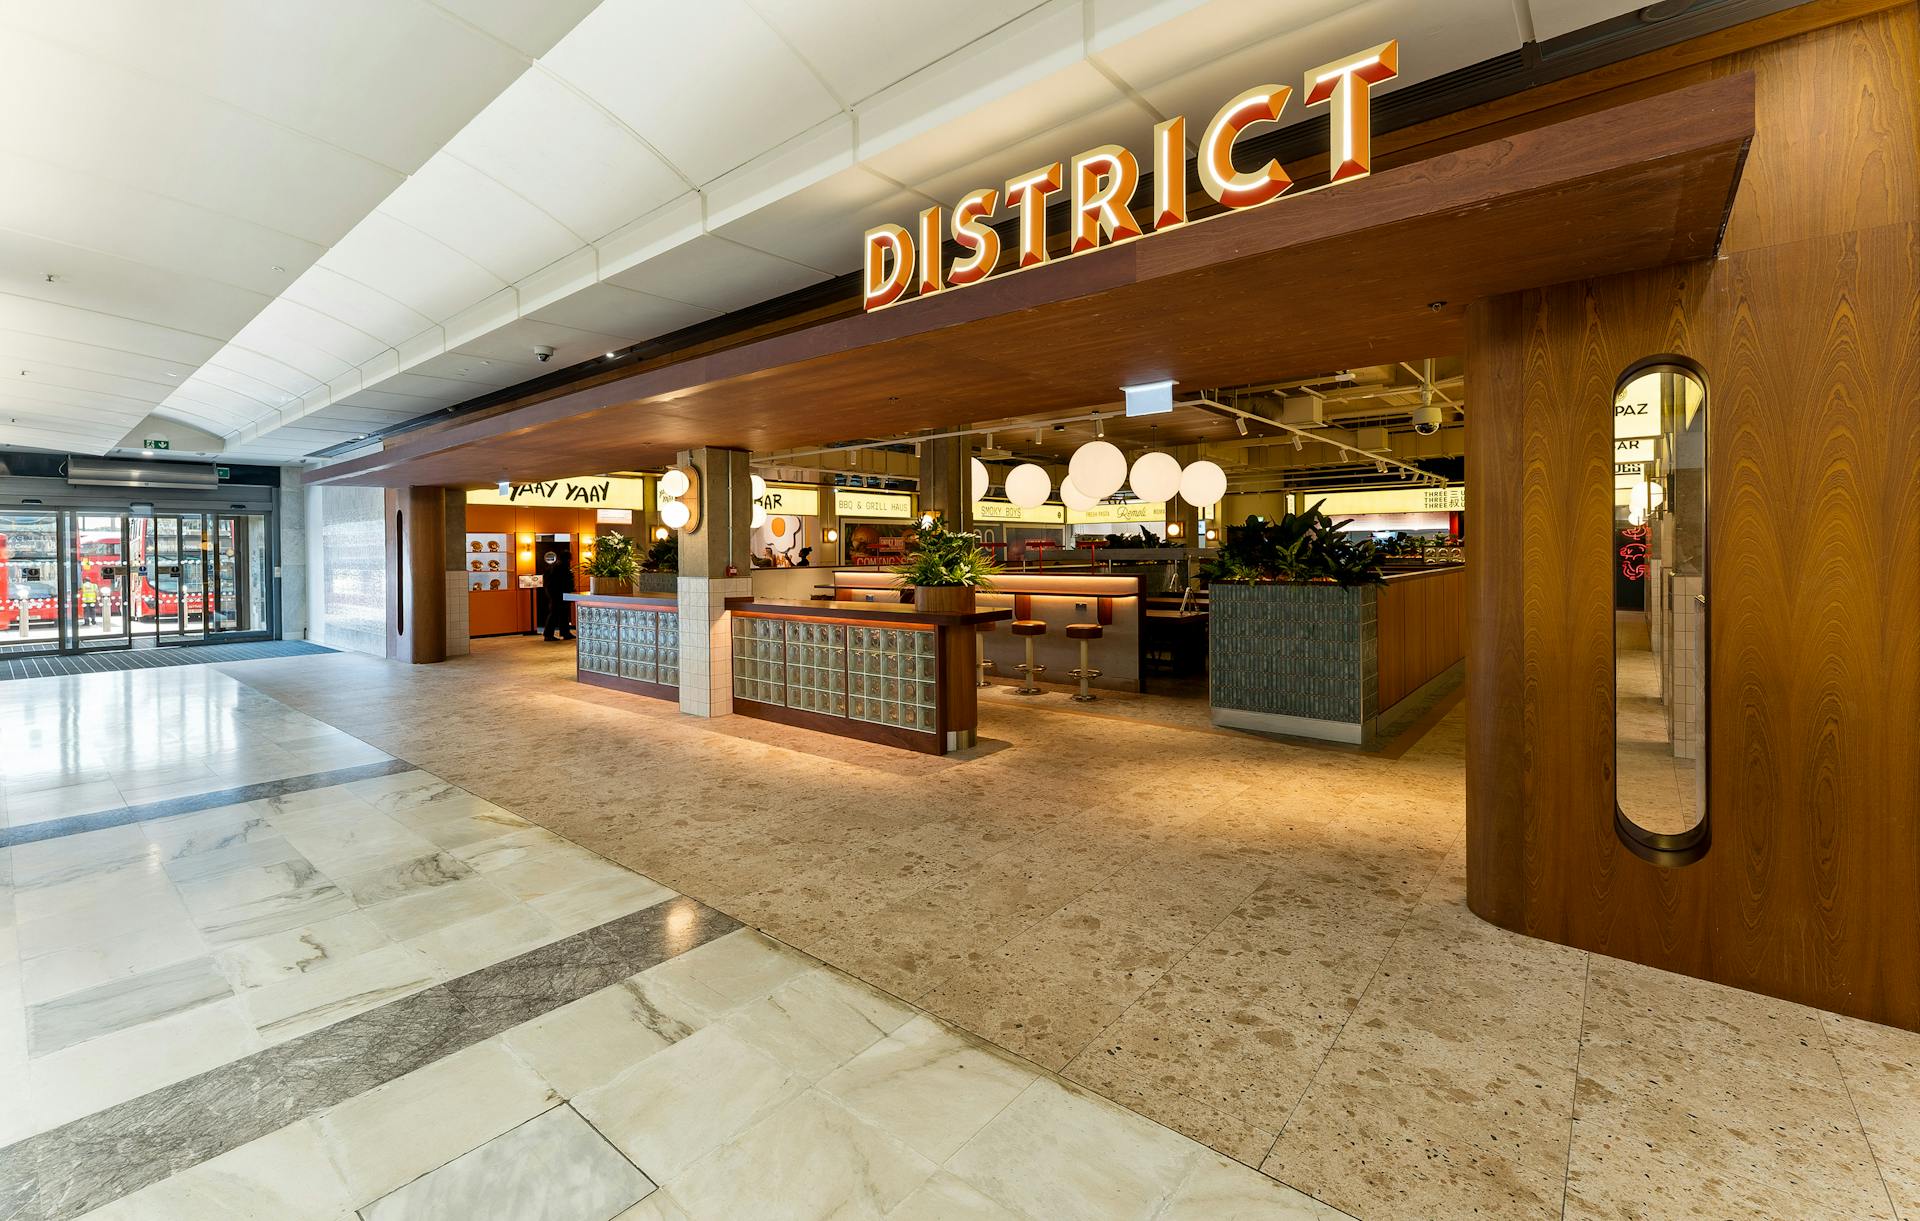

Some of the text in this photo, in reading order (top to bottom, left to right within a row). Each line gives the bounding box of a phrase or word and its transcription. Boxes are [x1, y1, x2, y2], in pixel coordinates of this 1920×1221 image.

[865, 39, 1397, 312] DISTRICT
[1615, 440, 1639, 450] AR
[565, 481, 610, 503] YAAY
[839, 500, 908, 512] BBQ & GRILL HAUS
[981, 506, 1022, 517] SMOKY BOYS
